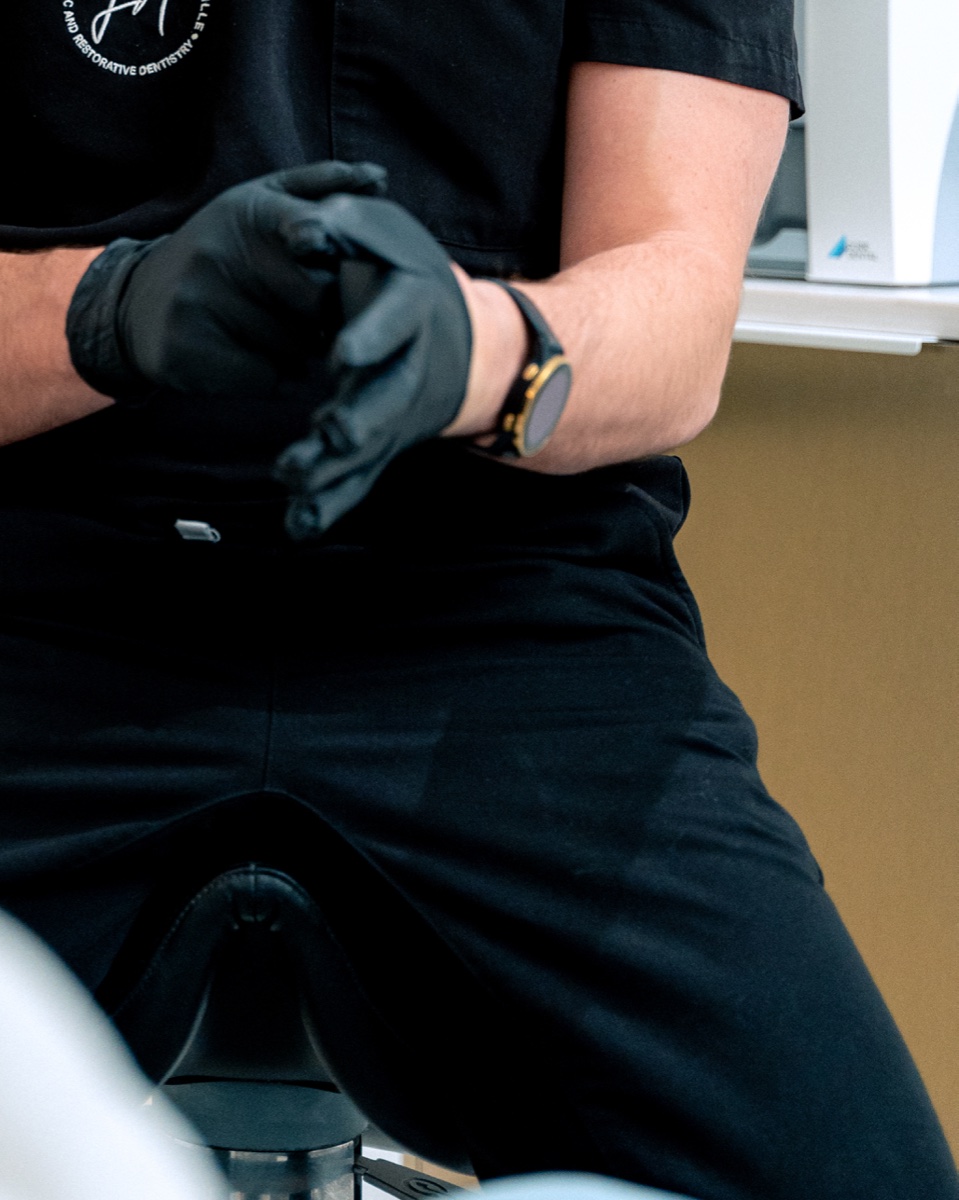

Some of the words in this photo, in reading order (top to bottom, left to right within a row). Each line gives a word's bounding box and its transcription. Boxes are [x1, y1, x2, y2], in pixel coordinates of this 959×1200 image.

[63, 11, 79, 34] AND
[72, 34, 137, 76] RESTORATIVE
[138, 39, 195, 77] DENTISTRY
